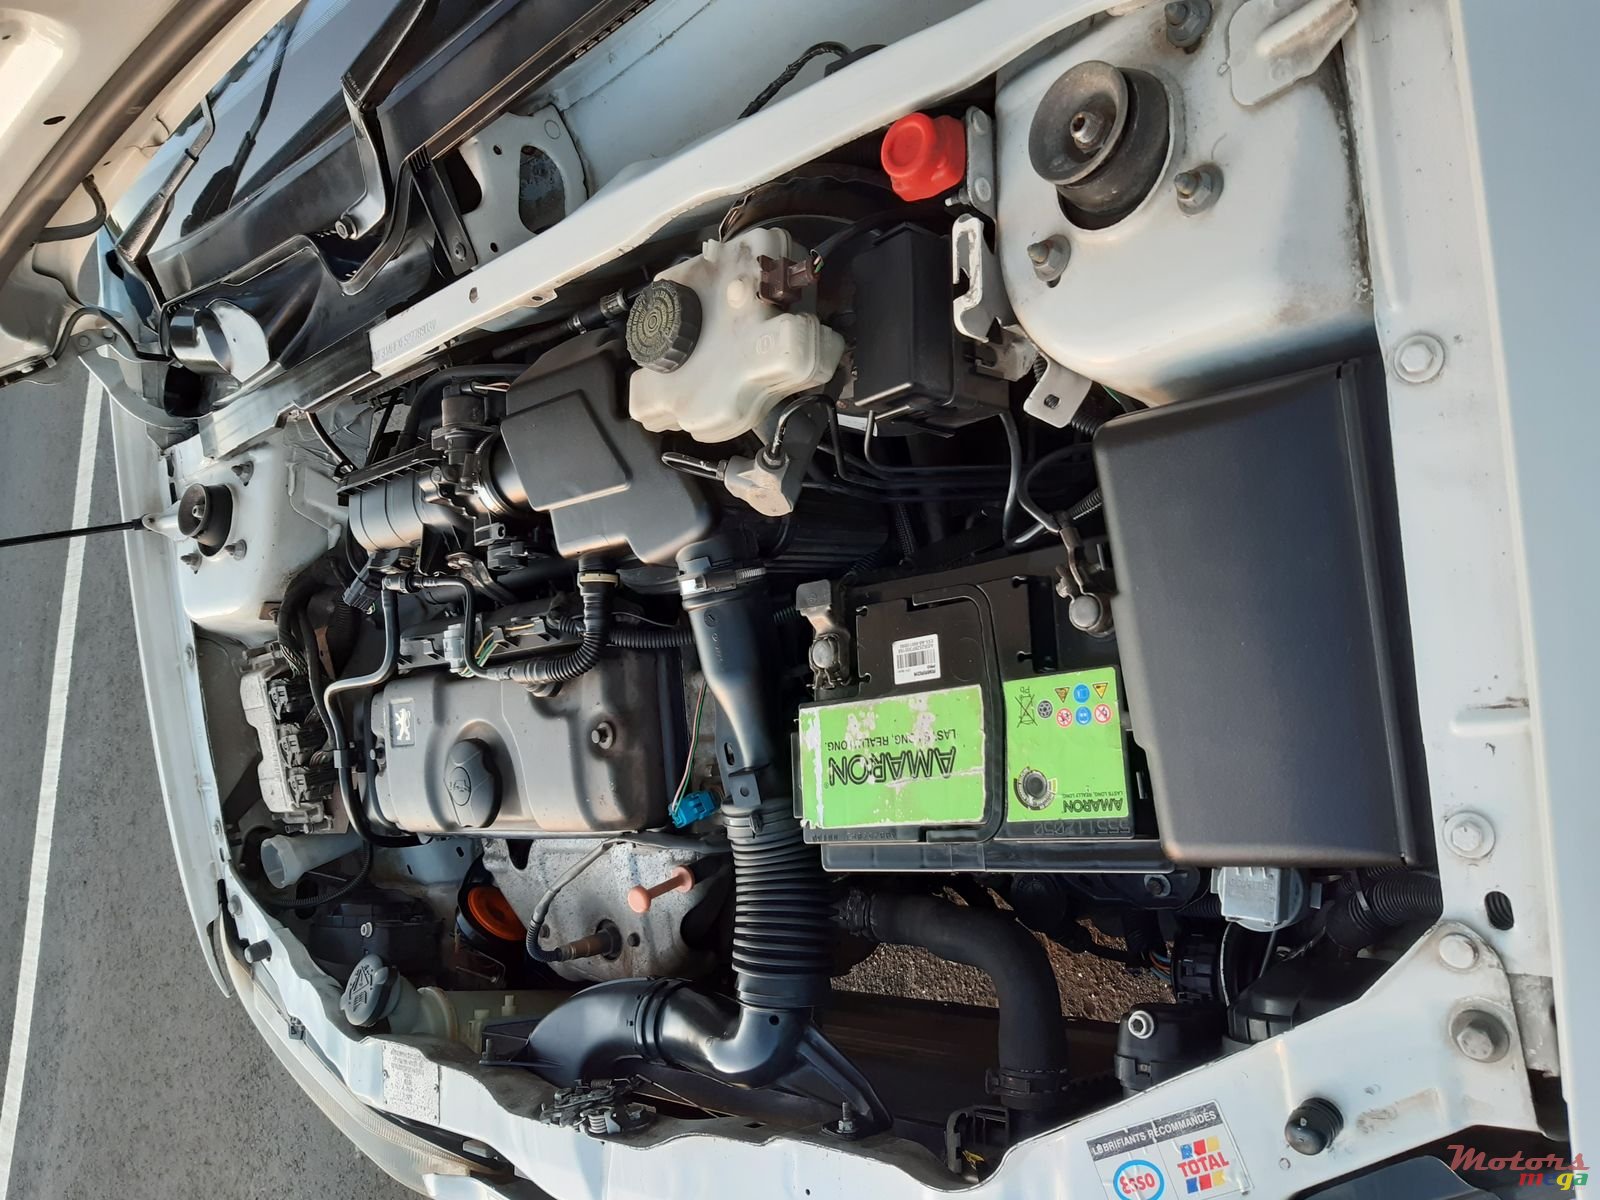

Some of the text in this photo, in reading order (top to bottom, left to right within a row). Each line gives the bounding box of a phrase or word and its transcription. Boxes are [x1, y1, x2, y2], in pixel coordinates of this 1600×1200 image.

[828, 746, 956, 786] AMARON
[1063, 798, 1123, 813] AMARON
[1092, 1132, 1146, 1155] LUBRIFIANTS
[1177, 1152, 1229, 1177] TOTAL
